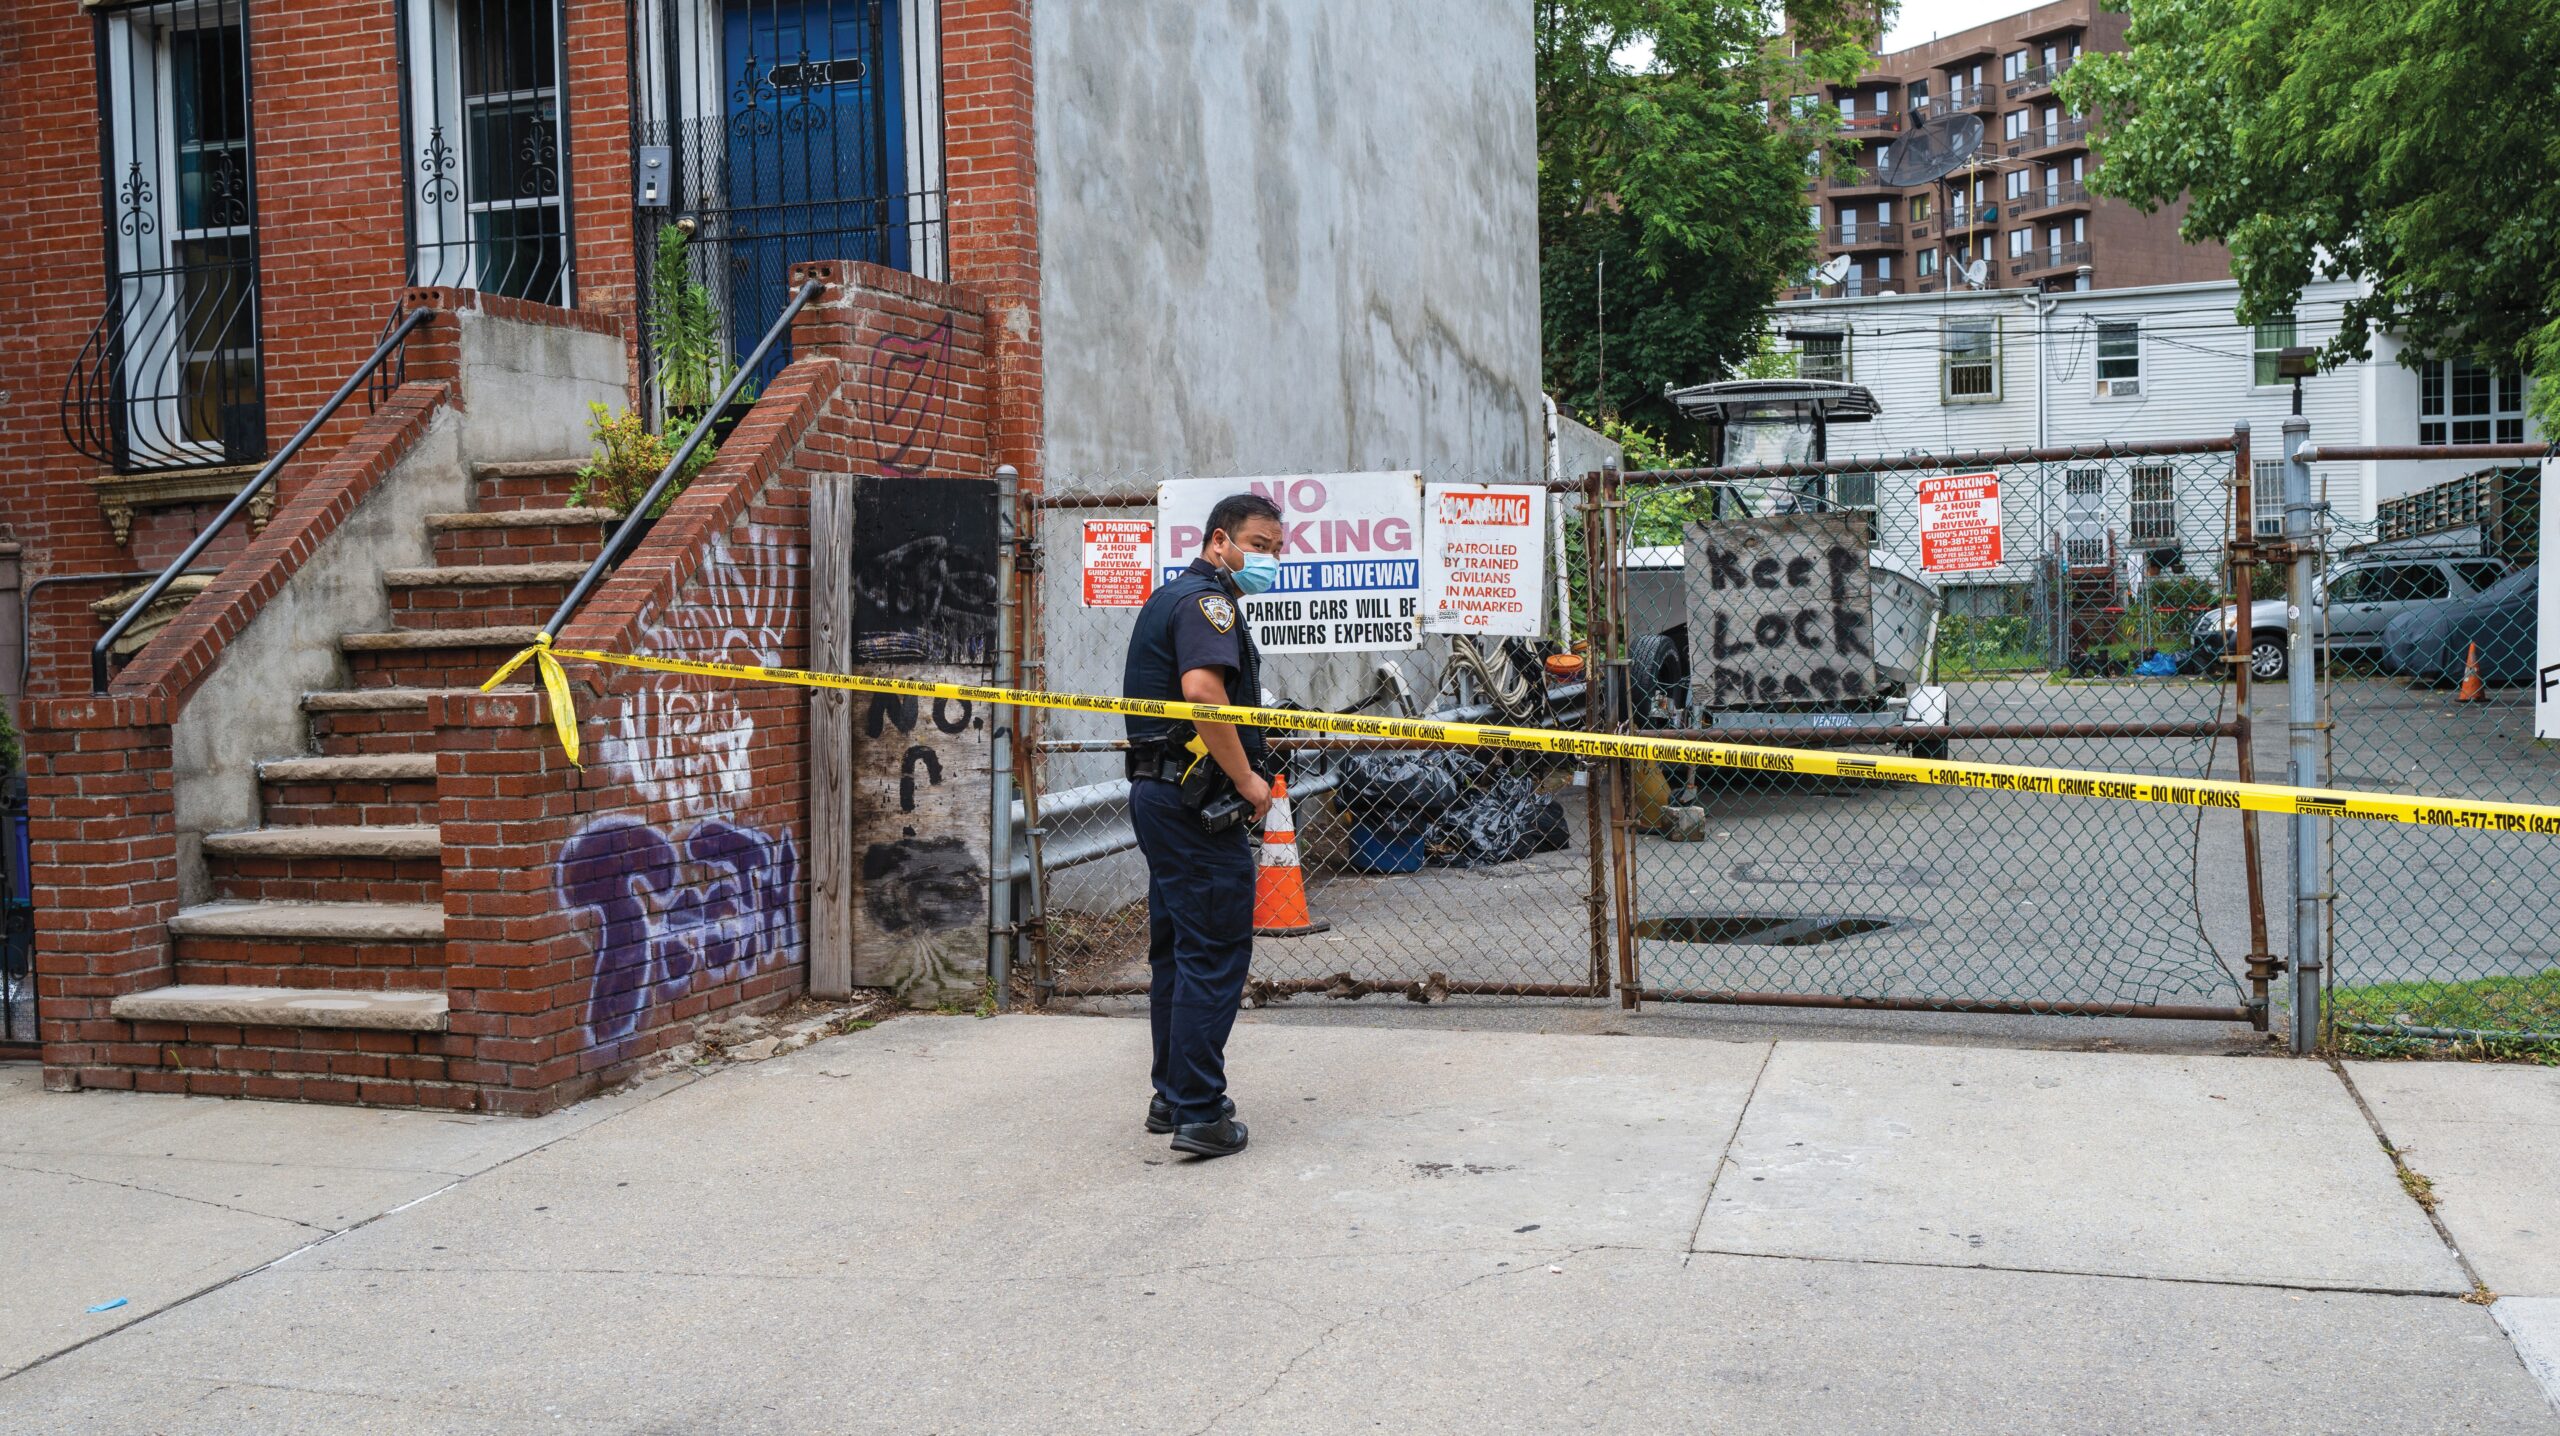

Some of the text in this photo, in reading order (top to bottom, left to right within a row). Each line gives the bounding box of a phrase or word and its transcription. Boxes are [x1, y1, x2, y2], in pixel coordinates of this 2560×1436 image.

[1926, 477, 1991, 491] NO PARKING
[1251, 479, 1326, 513] NO
[1933, 489, 1984, 502] ANY TIME
[1951, 501, 1981, 510] HOUR
[1941, 511, 1978, 520] ACTIVE
[1090, 523, 1146, 532] NO PARKING
[1933, 519, 1987, 529] DRIVEWAY
[1096, 534, 1141, 542] ANY TIME
[1170, 518, 1411, 558] PKING
[1926, 531, 1957, 539] GUIDO'S
[1934, 536, 1988, 546] 718-381-2150
[1448, 543, 1516, 555] PATROLLED
[1444, 557, 1518, 569] BY TRAINED
[1277, 565, 1313, 589] TIVE
[1321, 562, 1416, 588] DRIVEWAY
[1451, 572, 1510, 584] CIVILIANS
[1446, 586, 1516, 598] IN MARKED
[1246, 600, 1302, 622] PARKED
[1309, 599, 1348, 620] CARS
[1356, 598, 1392, 619] WILL
[1400, 597, 1416, 617] BE
[1439, 600, 1523, 612] & UNMARKED
[1464, 615, 1489, 626] CAR
[1261, 621, 1413, 646] OWNERS EXPENSES
[1813, 715, 1853, 727] VENTURE
[1332, 718, 1355, 732] CRIME
[1357, 720, 1382, 734] SCENE
[1390, 722, 1400, 736] DO
[1402, 723, 1419, 737] NOT
[1419, 725, 1445, 740] CROSS
[1652, 744, 1681, 761] CRIME
[1684, 747, 1714, 763] SCENE
[1725, 750, 1738, 766] DO
[1740, 751, 1759, 767] NOT
[1761, 752, 1794, 771] CROSS
[1928, 768, 2015, 790] 1-800-577-TIPS
[2058, 778, 2096, 796] CRIME
[2099, 780, 2137, 799] SCENE
[2152, 784, 2167, 802] DO
[2172, 786, 2196, 805] NOT
[2199, 788, 2240, 808] CROSS
[2413, 808, 2526, 832] 1-800-577-TIPS
